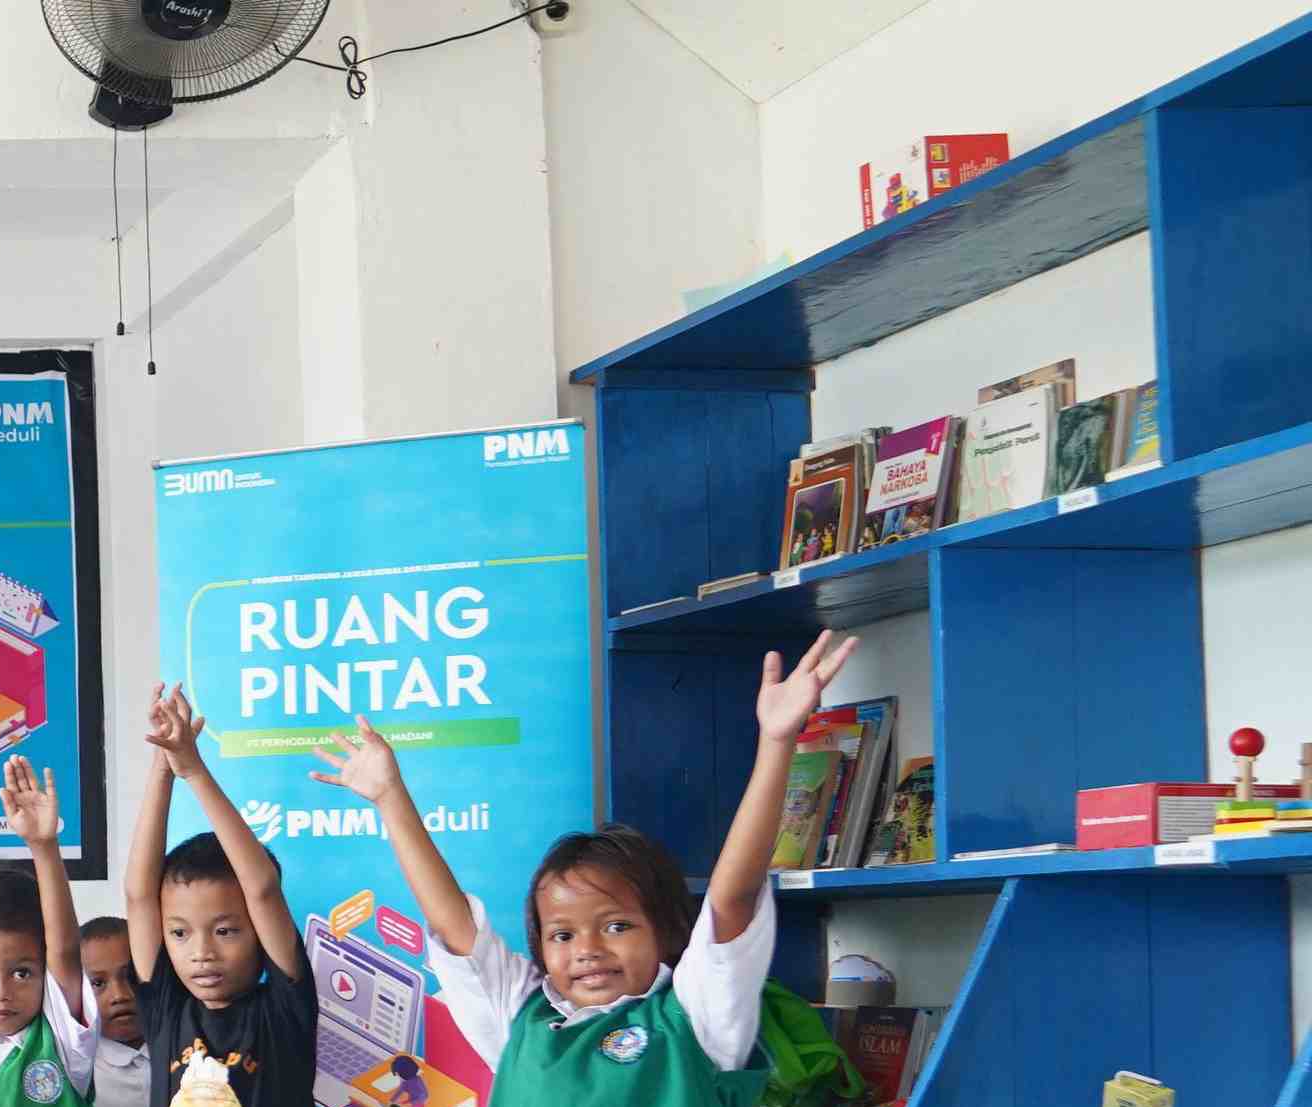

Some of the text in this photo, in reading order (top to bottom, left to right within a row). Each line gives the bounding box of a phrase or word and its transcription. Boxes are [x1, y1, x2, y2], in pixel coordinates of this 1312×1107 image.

[483, 428, 570, 461] PNM
[887, 459, 927, 481] BAHAYA
[239, 586, 491, 653] RUANG
[240, 655, 493, 718] PINTAR
[286, 803, 490, 841] PNM duli
